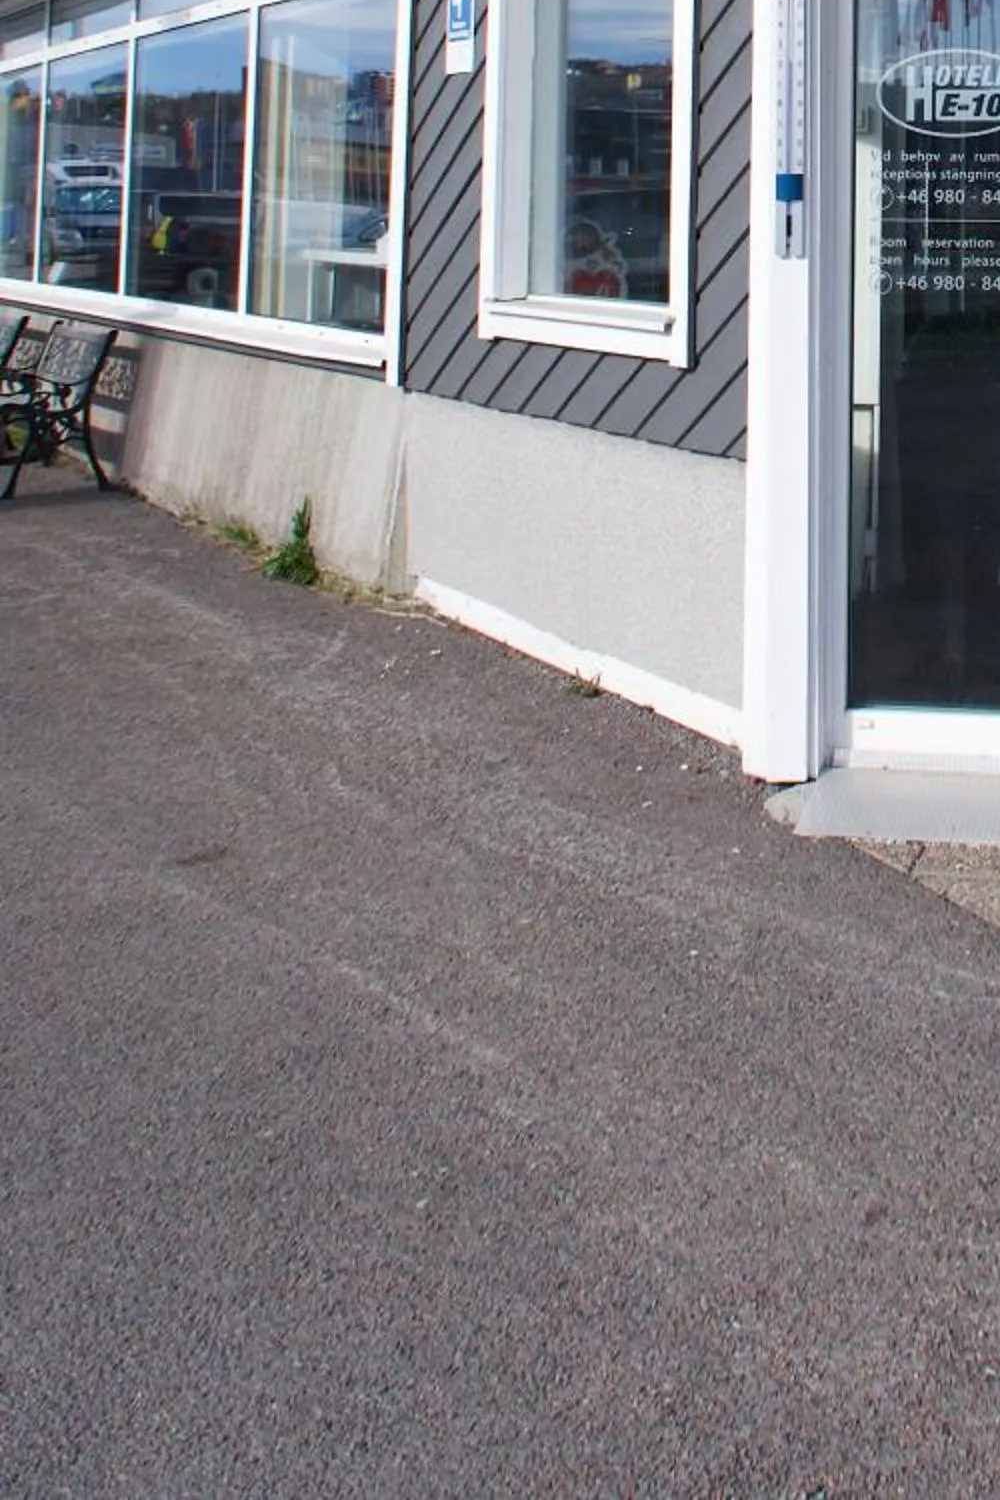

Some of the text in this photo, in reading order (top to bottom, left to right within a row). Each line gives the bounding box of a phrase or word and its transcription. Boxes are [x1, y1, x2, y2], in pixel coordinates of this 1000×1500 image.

[870, 150, 891, 162] Vd
[901, 150, 940, 162] behov
[949, 153, 965, 162] av
[974, 153, 1000, 162] rum
[933, 189, 965, 205] 980
[922, 236, 994, 249] reservation
[913, 254, 950, 267] hours
[896, 276, 929, 291] +46
[933, 275, 965, 291] 980
